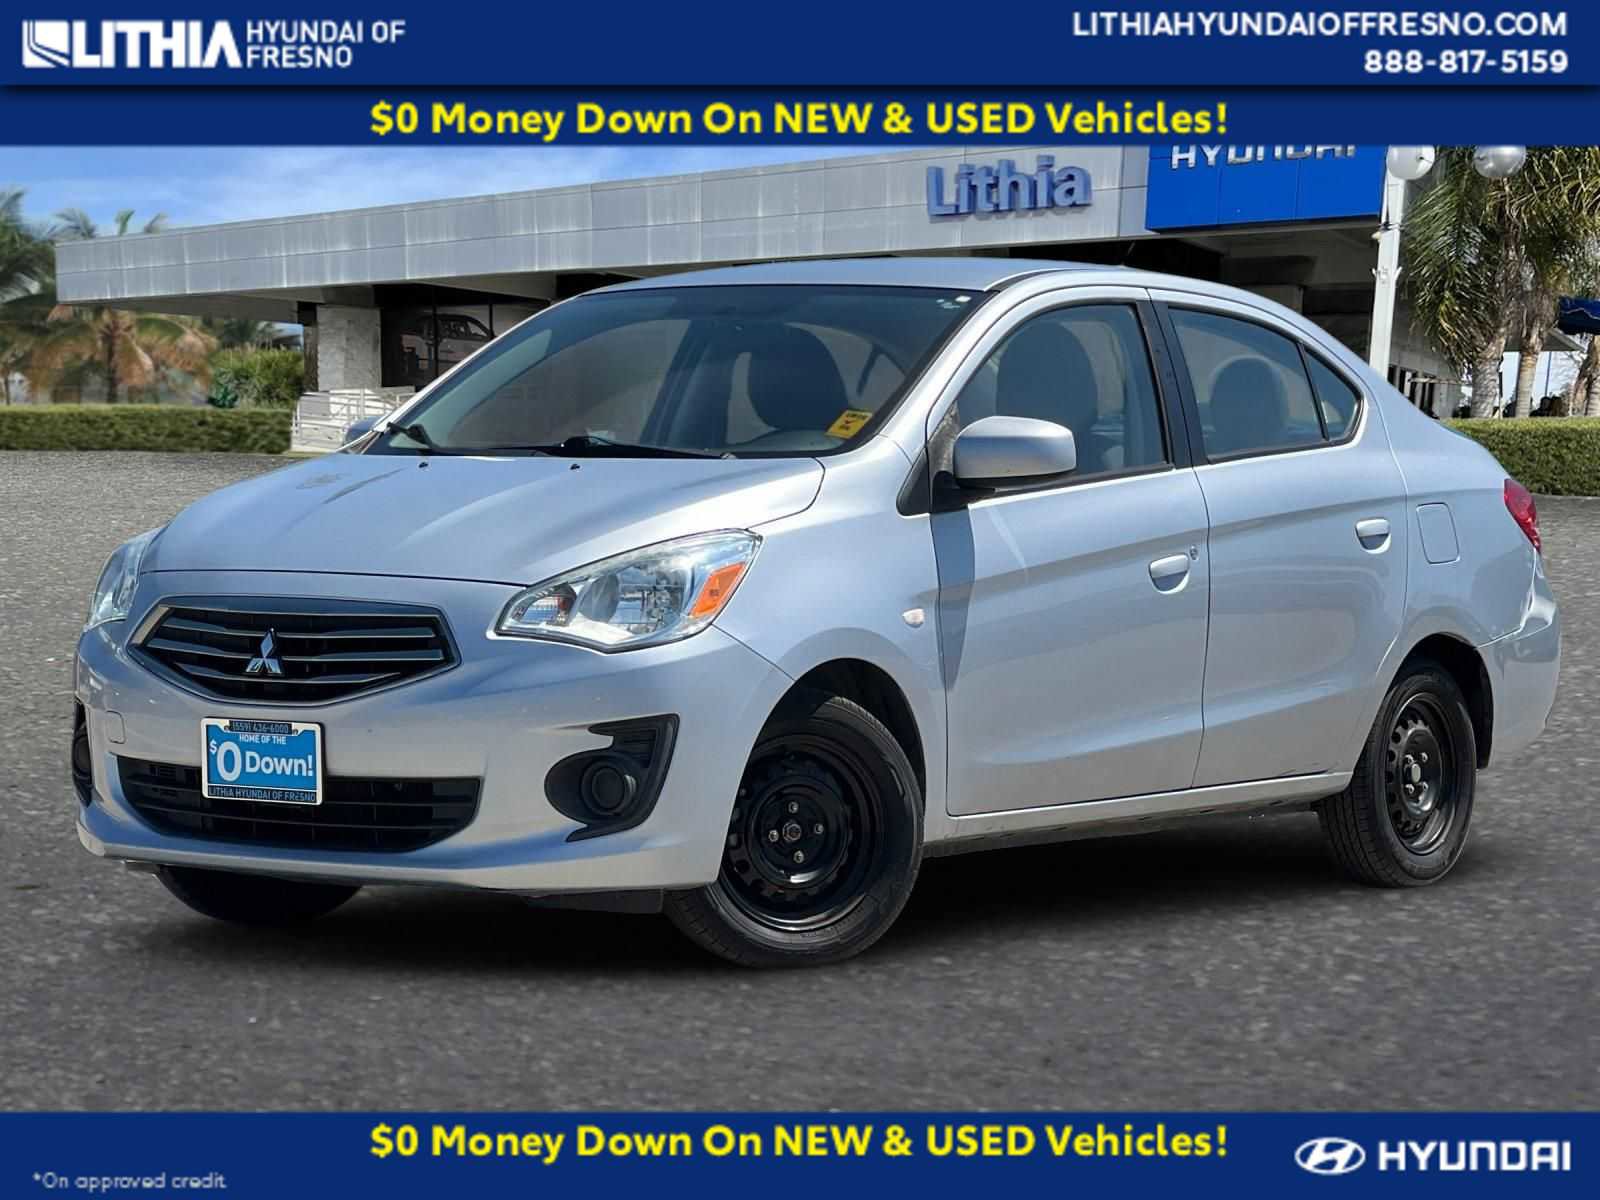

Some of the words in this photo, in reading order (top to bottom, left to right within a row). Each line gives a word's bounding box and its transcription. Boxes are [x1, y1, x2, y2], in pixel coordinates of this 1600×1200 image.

[926, 154, 1092, 216] Lithia
[239, 734, 260, 743] HOME
[261, 735, 271, 743] OF
[272, 736, 287, 745] THE
[245, 750, 314, 777] Down!
[208, 786, 234, 796] LITHIA
[235, 788, 271, 800] HYUNDAI
[272, 791, 283, 800] OF
[284, 791, 316, 802] FRESNO
